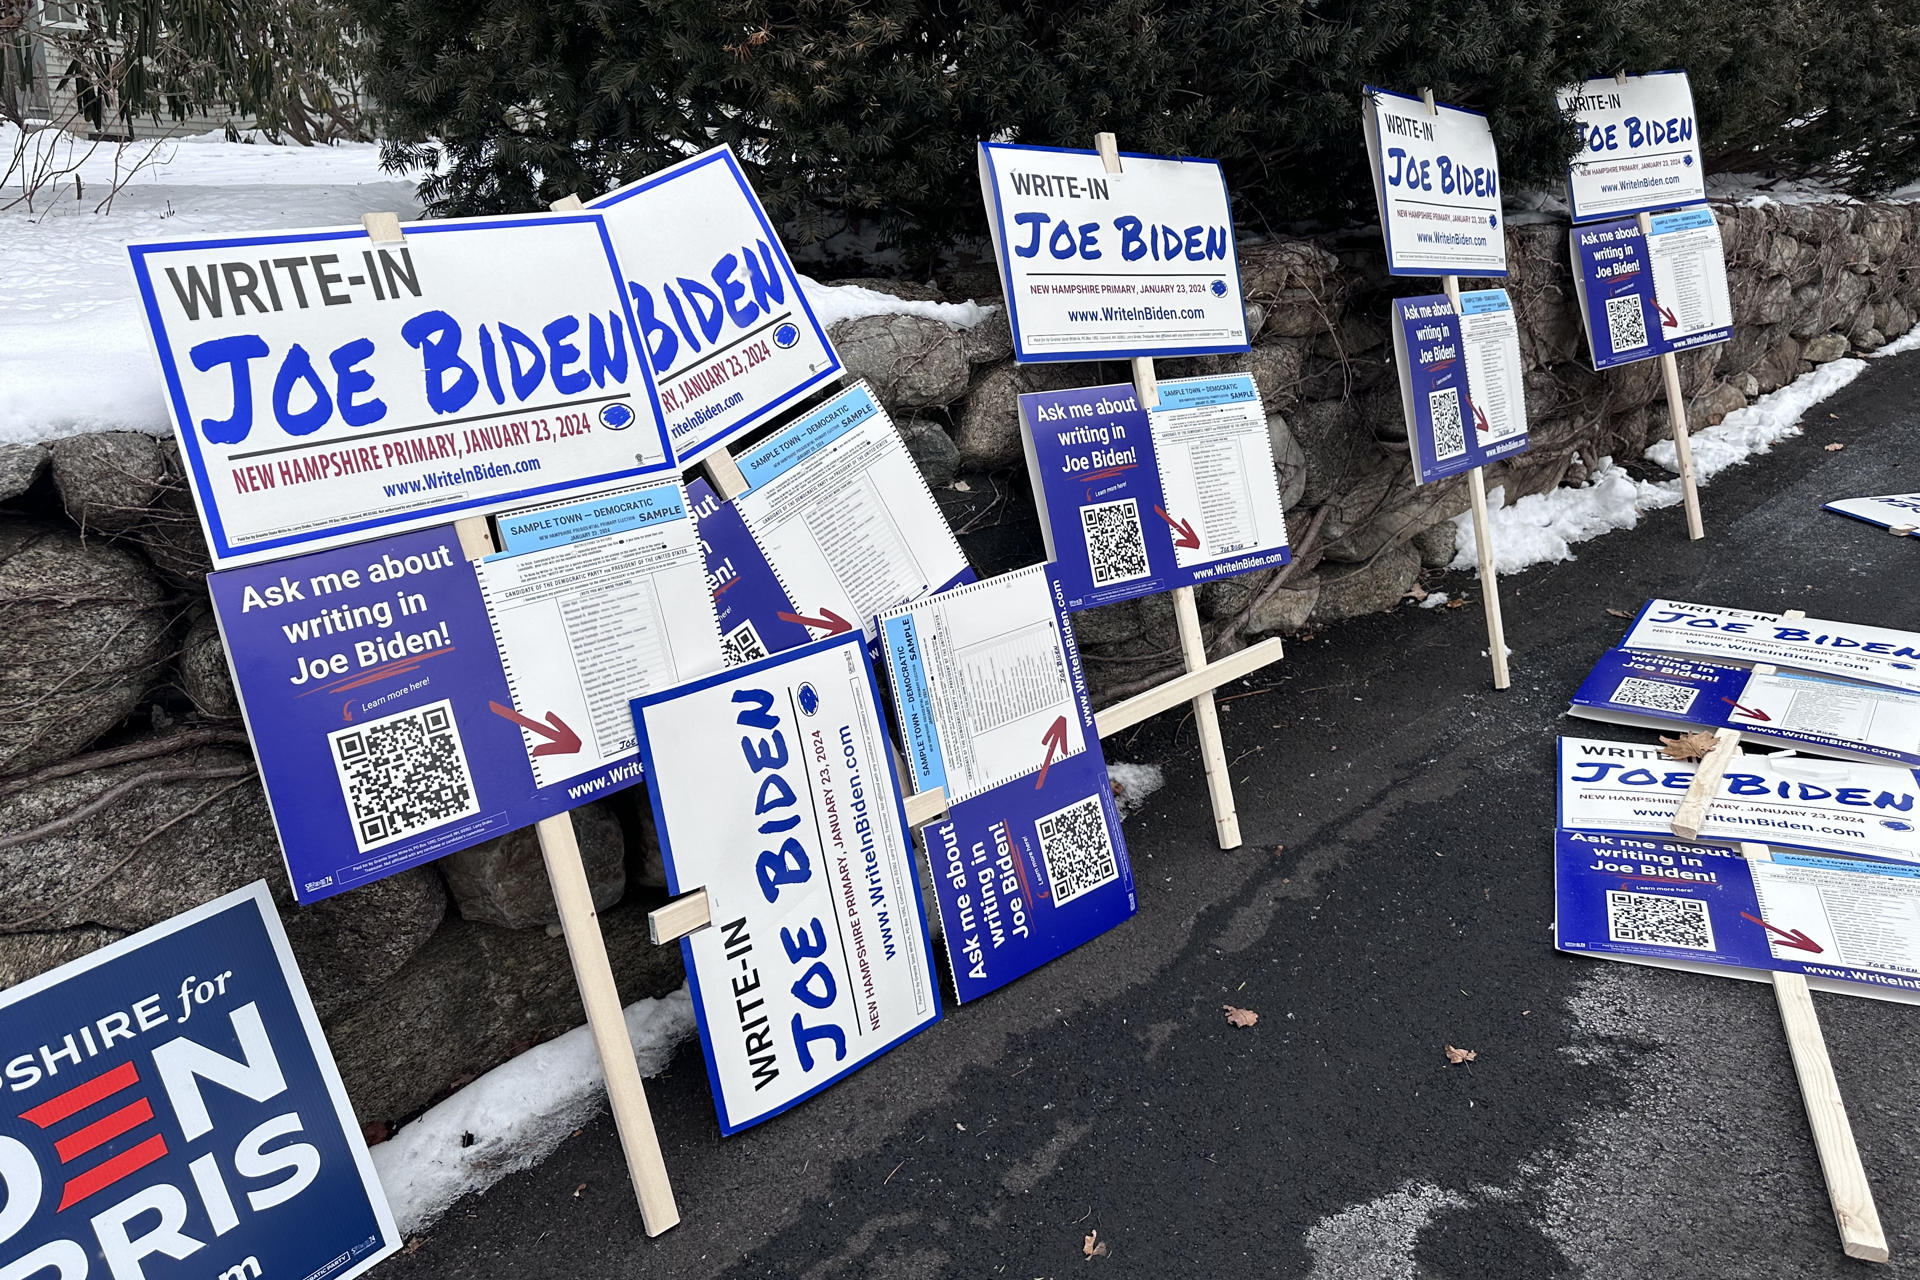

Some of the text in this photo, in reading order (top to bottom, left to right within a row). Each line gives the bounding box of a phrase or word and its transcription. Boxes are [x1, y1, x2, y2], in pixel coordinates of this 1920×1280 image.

[1566, 93, 1621, 111] WRITE-IN
[1385, 113, 1434, 142] WRITE-IN
[1624, 116, 1692, 148] BIDEN
[1011, 173, 1109, 200] WRITE-IN
[1388, 147, 1496, 197] JOE BIDEN
[1601, 175, 1679, 193] www.WriteInBiden.com
[1014, 212, 1227, 262] JOE BIDEN
[1417, 231, 1487, 246] www.WriteInBiden.com
[1580, 226, 1640, 246] Ask me about
[1593, 244, 1633, 261] writing in
[164, 247, 422, 320] WRITE-IN
[1595, 260, 1640, 279] Joe Biden!
[1030, 284, 1205, 294] NEW HAMPSHIRE PRIMARY, JANUARY 23, 2024
[629, 239, 784, 376] BIDEN
[1068, 307, 1205, 322] www.WriteInBiden.com
[1404, 305, 1420, 320] Ask
[1418, 304, 1433, 319] me
[1430, 302, 1454, 317] about
[1416, 324, 1450, 342] writing in
[1673, 330, 1728, 348] www.WriteInBiden.com
[1420, 344, 1455, 364] Joe Biden!
[190, 335, 387, 444] JOE
[401, 309, 628, 415] BIDEN
[678, 361, 729, 403] JANUARY
[725, 355, 748, 376] 23,
[742, 340, 771, 367] 2024
[1164, 383, 1238, 397] SAMPLE TOWN DEMOCRATIC
[1230, 391, 1254, 399] SAMPLE
[671, 391, 744, 439] riteInBiden.com
[840, 404, 873, 428] SAMPLE
[1038, 396, 1138, 422] Ask me about
[749, 404, 849, 470] SAMPLE TOWN DEMOCRATIC
[1057, 423, 1125, 445] writing in
[232, 412, 590, 493] NEW HAMPSHIRE PRIMARY, JANUARY 23, 2024
[1061, 446, 1137, 472] Joe Biden!
[382, 458, 541, 498] www.WriteInBiden.com
[510, 498, 653, 535] SAMPLE TOWN DEMOCRATIC
[638, 505, 682, 522] SAMPLE
[242, 545, 453, 613] Ask me about
[1193, 553, 1282, 580] www.WriteInBiden.com
[283, 592, 427, 643] writing in
[1668, 603, 1777, 622] WRITE-IN
[902, 618, 917, 661] SAMPLE
[1649, 611, 1920, 660] JOE BIDEN
[290, 621, 450, 684] Joe Biden!
[1053, 580, 1093, 727] www.WriteInBiden.com
[1631, 655, 1714, 674] writing in
[1686, 639, 1869, 670] www.WriteInBiden.com
[1622, 662, 1656, 671] Joe
[1660, 667, 1719, 682] Biden!
[361, 676, 429, 711] Learn more here!
[897, 646, 929, 776] SAMPLE TOWN DEMOCRATIC
[1746, 725, 1901, 758] www.WriteInBiden.com
[1571, 762, 1914, 811] JOE BIDEN
[1609, 796, 1681, 805] HAMPSHIRE
[1747, 807, 1864, 823] JANUARY 23, 2024
[839, 725, 896, 961] www.WriteInBiden.com
[1570, 832, 1731, 858] Ask me about
[1593, 848, 1702, 867] writing in
[1021, 836, 1044, 887] Learn more here!
[1589, 860, 1717, 883] Joe Biden!
[732, 688, 847, 1073] JOE BIDEN
[811, 730, 880, 1031] NEW HAMPSHIRE PRIMARY, JANUARY 23, 2024
[971, 841, 1006, 949] writing in
[988, 822, 1029, 939] Joe Biden!
[936, 822, 986, 977] Ask me about
[722, 916, 780, 1091] WRITE-IN
[0, 970, 233, 1092] SHIRE for
